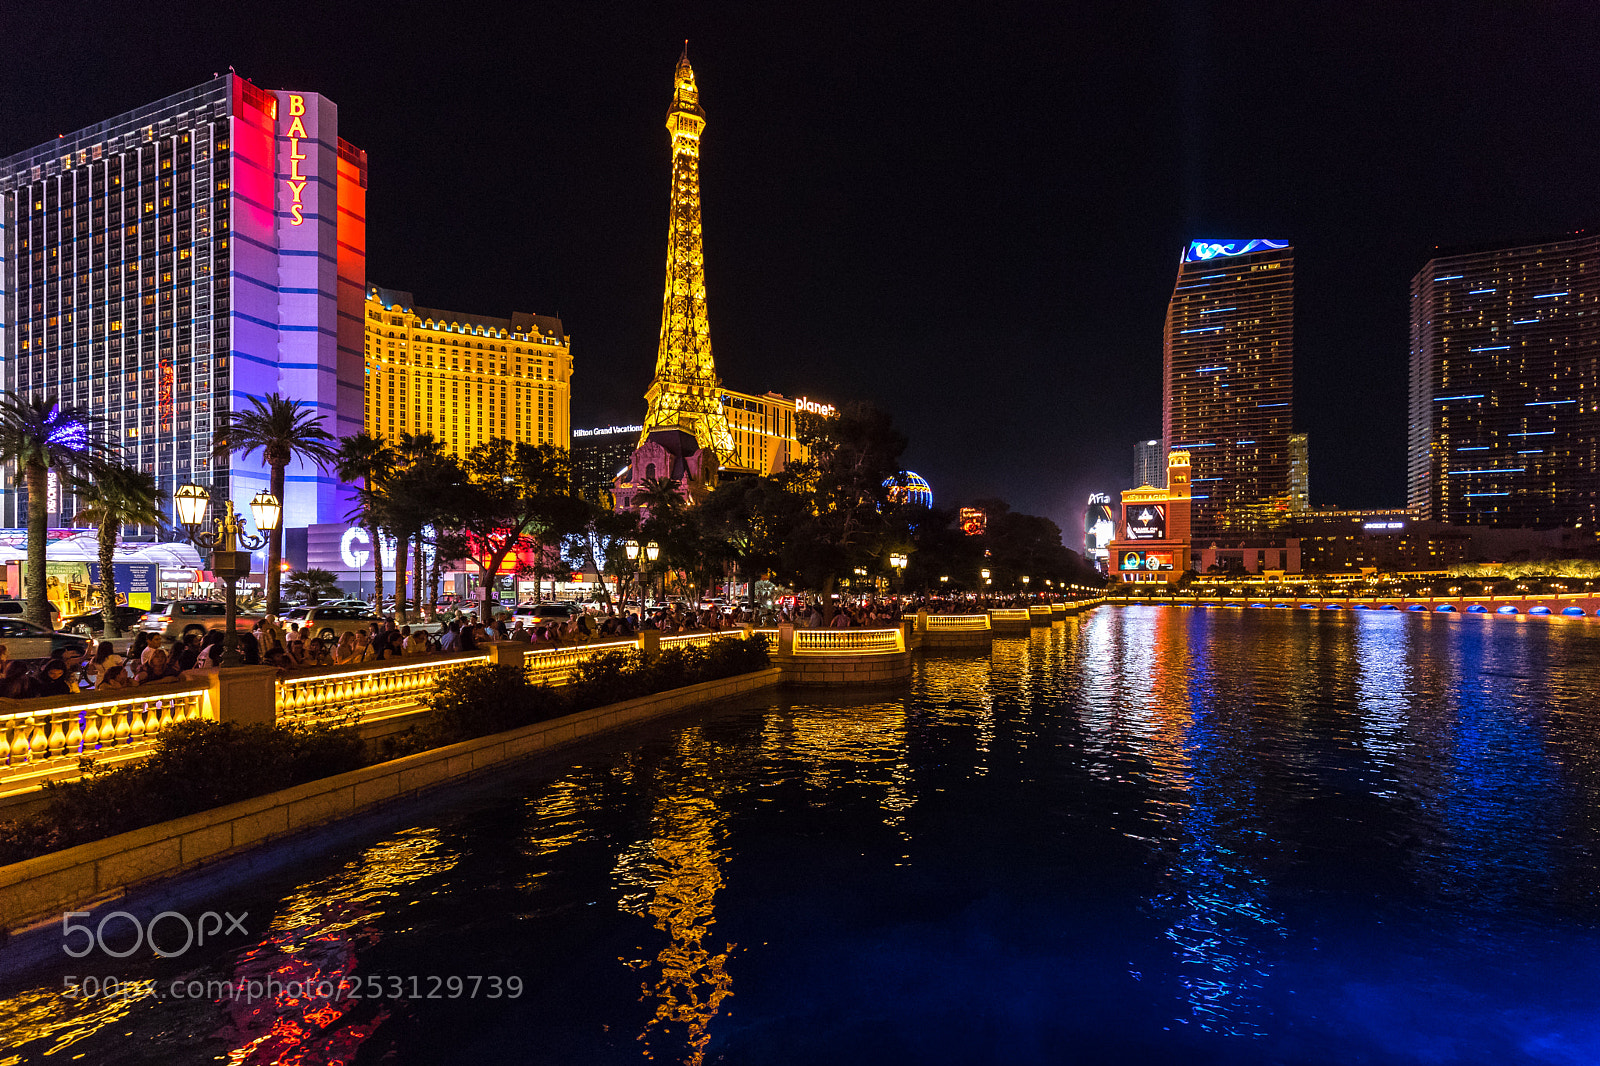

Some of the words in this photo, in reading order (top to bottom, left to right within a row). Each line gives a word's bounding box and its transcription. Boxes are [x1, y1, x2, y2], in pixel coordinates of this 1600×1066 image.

[287, 94, 308, 226] BALLYS
[795, 396, 836, 417] planet
[573, 428, 593, 437] Hilton
[593, 426, 613, 435] Grand
[613, 424, 643, 433] Vacations
[1088, 492, 1111, 505] Aria
